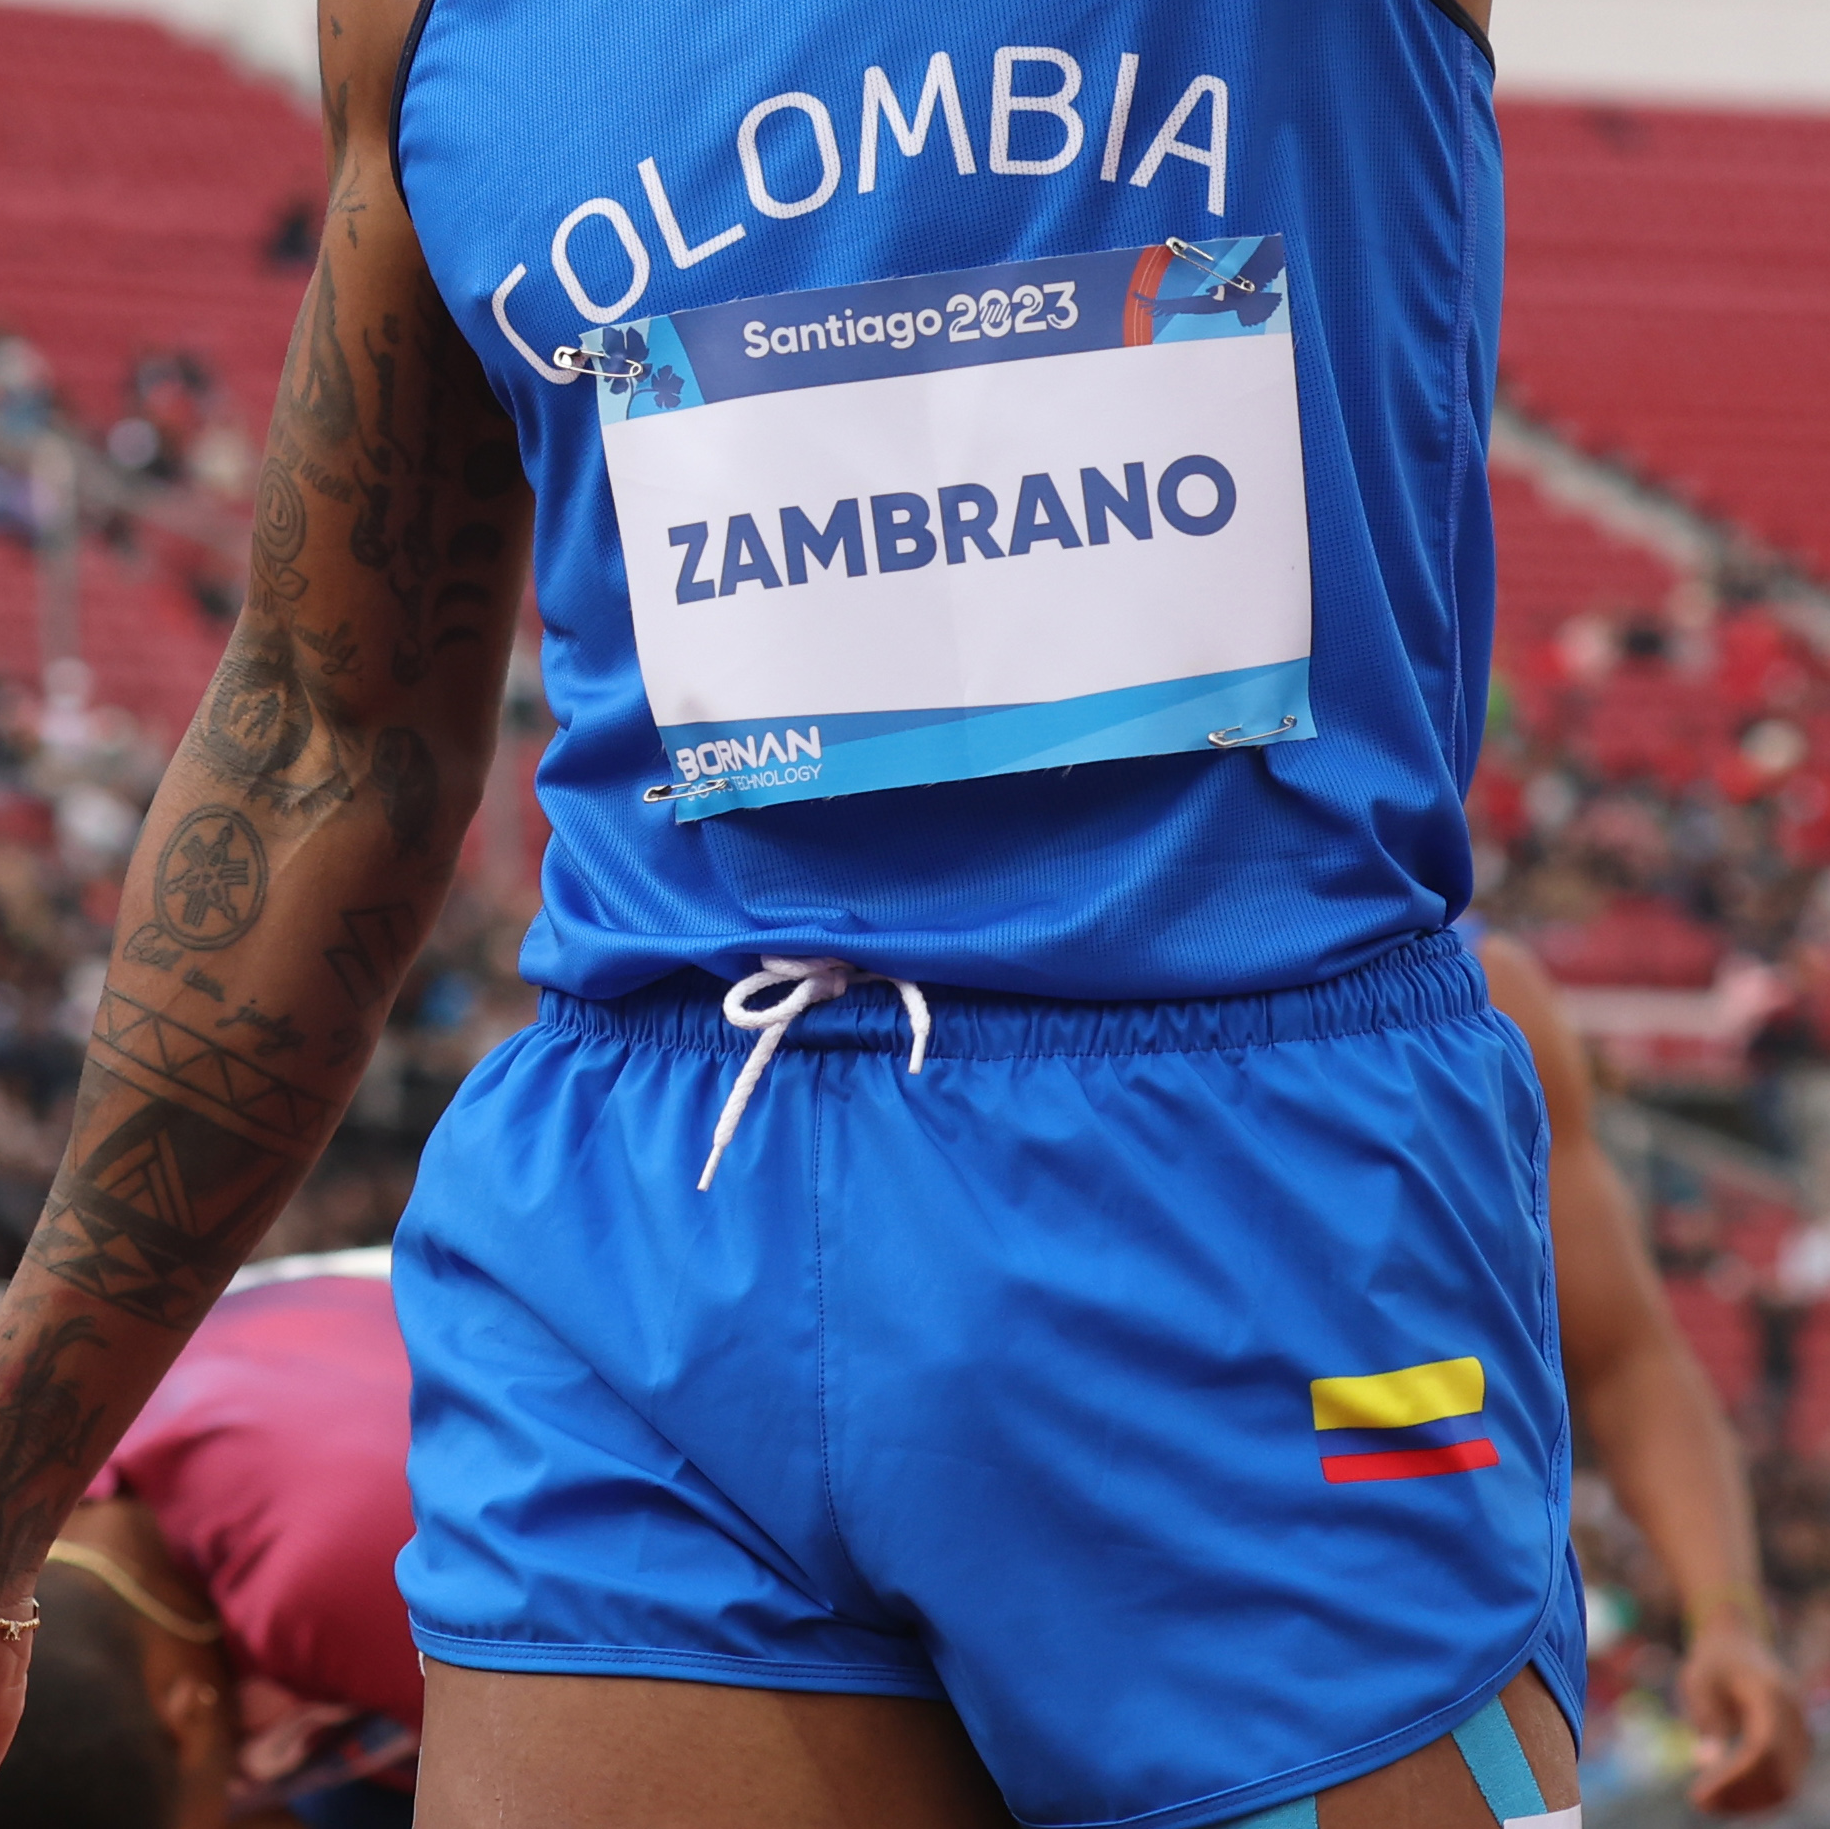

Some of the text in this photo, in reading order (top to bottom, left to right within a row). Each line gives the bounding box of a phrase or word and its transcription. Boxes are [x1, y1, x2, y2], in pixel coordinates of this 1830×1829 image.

[491, 45, 1229, 385] COLOMBIA
[742, 280, 1079, 359] Santiago 2023
[667, 454, 1237, 606] ZAMBRANO
[675, 725, 823, 783] BORNAN
[731, 763, 823, 793] TECHNOLOGY
